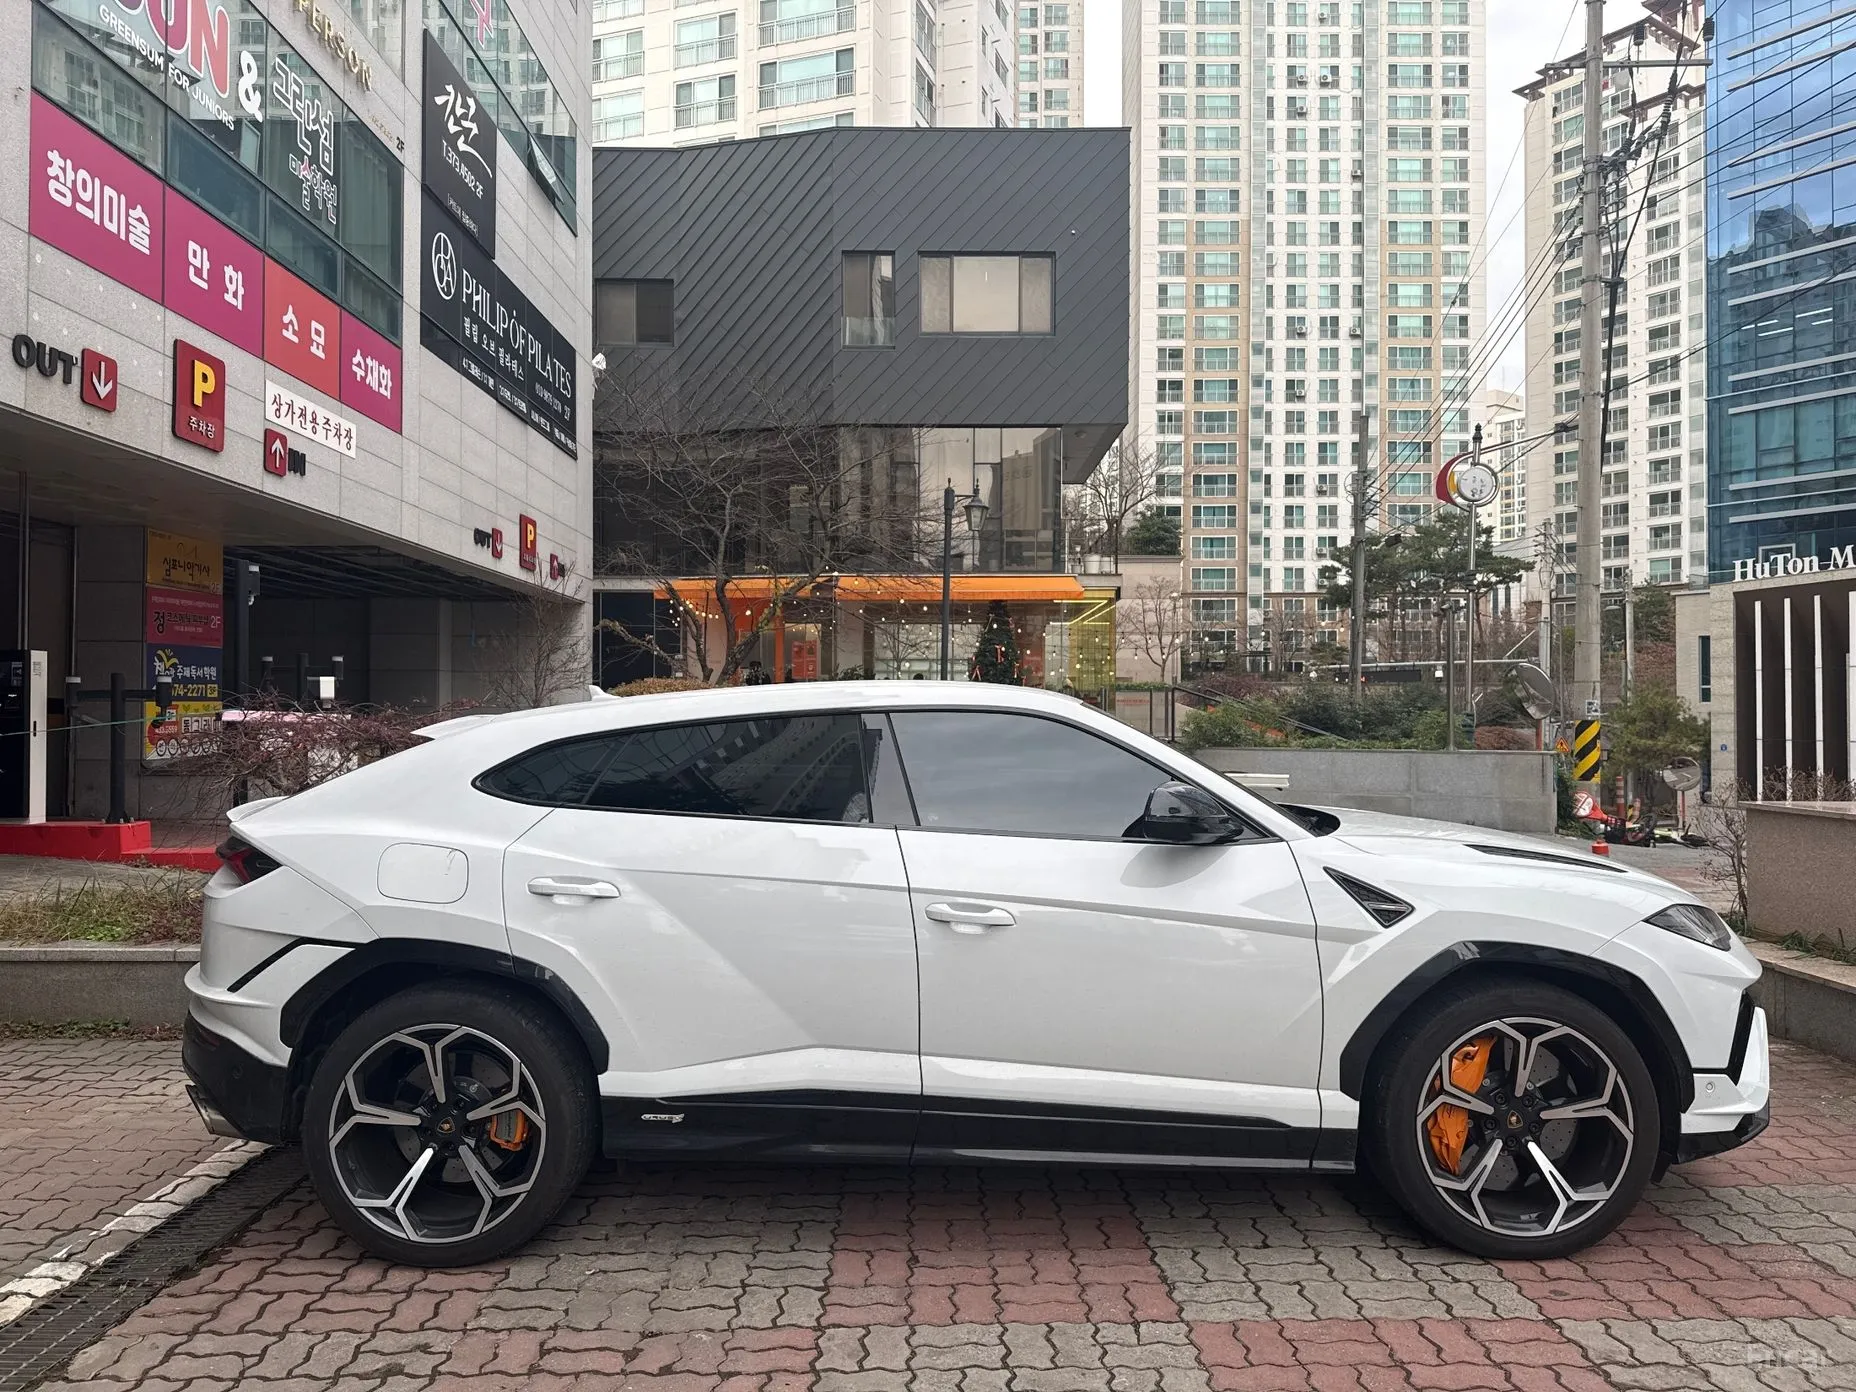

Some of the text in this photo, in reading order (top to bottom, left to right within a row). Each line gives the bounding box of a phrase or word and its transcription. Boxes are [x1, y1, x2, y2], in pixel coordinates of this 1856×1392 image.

[99, 4, 235, 131] GREENSUM FOR JUNIORS
[113, 0, 264, 123] UN &
[46, 149, 152, 256] 창의미술
[289, 153, 337, 224] 미술학원
[462, 267, 509, 338] PHILIP
[527, 332, 572, 398] PILATES
[12, 334, 77, 384] OUT
[192, 359, 216, 408] P
[351, 348, 393, 400] 수채화
[188, 416, 216, 439] 주차장
[527, 523, 535, 549] P
[1733, 552, 1821, 582] HuTon
[210, 615, 221, 629] 2F
